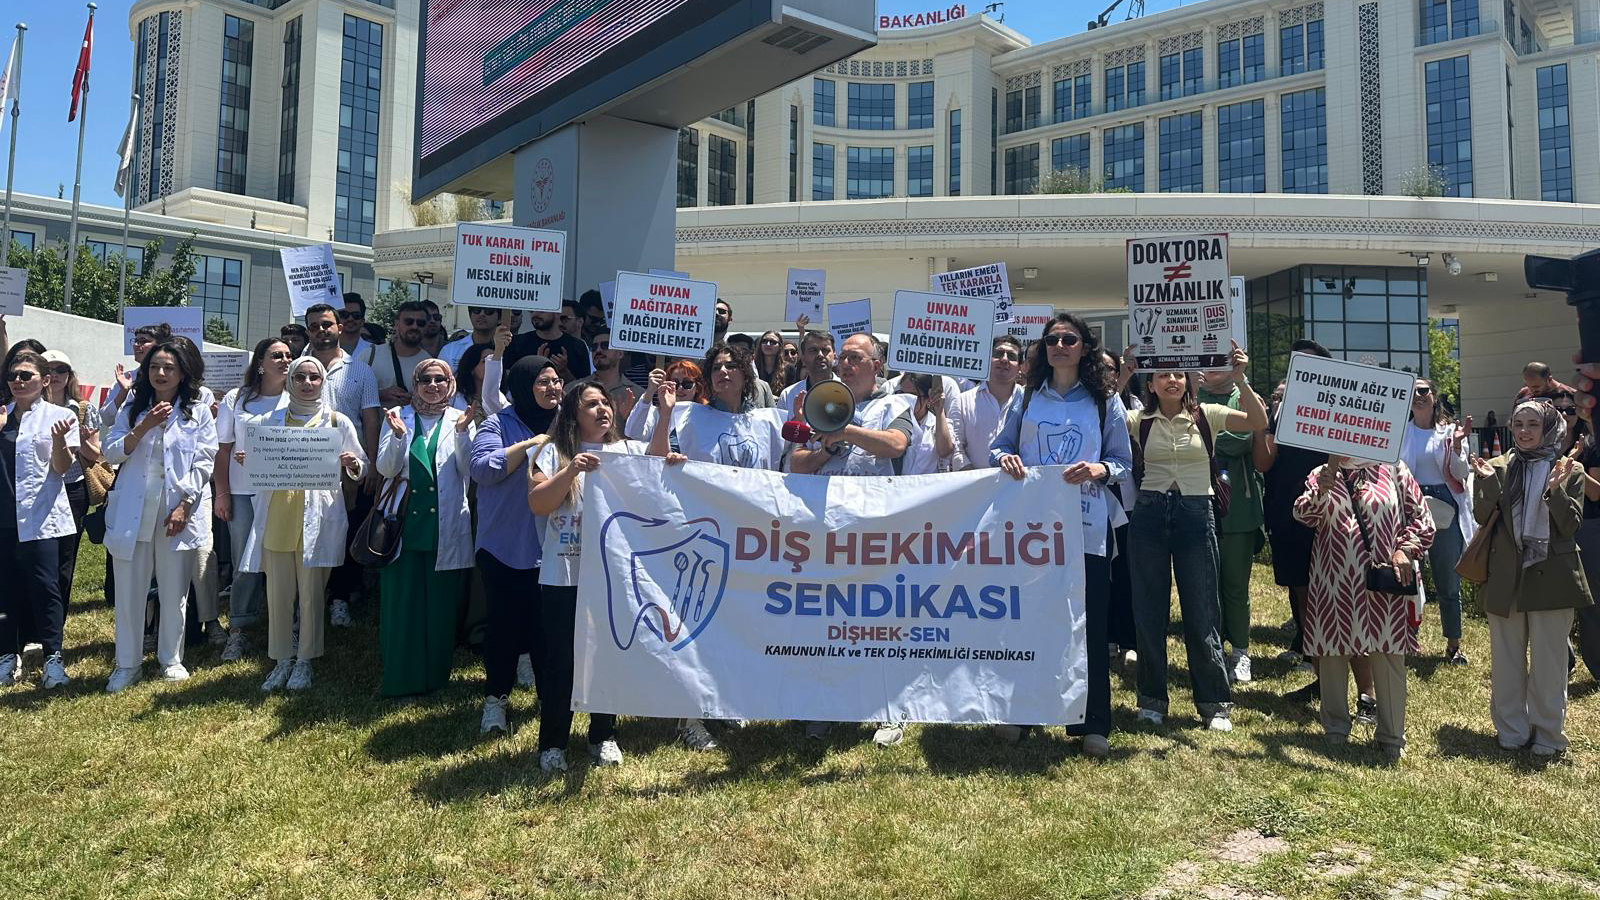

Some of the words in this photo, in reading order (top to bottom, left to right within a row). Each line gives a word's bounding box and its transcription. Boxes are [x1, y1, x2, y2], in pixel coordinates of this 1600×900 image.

[880, 4, 965, 28] BAKANLIĞI
[462, 234, 482, 246] TUK
[486, 236, 524, 250] KARARI
[532, 238, 560, 254] İPTAL
[1132, 238, 1222, 264] DOKTORA
[490, 252, 533, 269] EDİLSİN,
[466, 268, 513, 282] MESLEKİ
[516, 270, 551, 286] BİRLİK
[938, 270, 973, 283] YILLARIN
[974, 265, 999, 276] EMEĞİ
[941, 282, 957, 292] TEK
[960, 274, 1002, 288] KARARLA
[476, 286, 539, 301] KORUNSUN!
[650, 284, 690, 299] UNVAN
[1134, 280, 1224, 303] UZMANLIK
[630, 298, 698, 316] DAĞITARAK
[927, 302, 968, 317] UNVAN
[1206, 306, 1225, 318] DUS
[622, 313, 702, 332] MAĞDURİYET
[907, 317, 976, 336] DAĞITARAK
[1166, 316, 1198, 324] SINAVIYLA
[619, 328, 705, 349] GİDERİLEMEZ!
[1008, 325, 1028, 336] EMEĞİ
[900, 333, 980, 353] MAĞDURİYET
[896, 349, 983, 371] GİDERİLEMEZ!
[1295, 370, 1358, 391] TOPLUMUN
[1360, 381, 1389, 397] AĞIZ
[1392, 388, 1407, 400] VE
[1317, 390, 1336, 407] DİŞ
[1339, 396, 1385, 414] SAĞLIĞI
[1296, 405, 1331, 421] KENDİ
[1334, 412, 1392, 433] KADERİNE
[1296, 422, 1325, 437] TERK
[1328, 425, 1389, 449] EDİLEMEZ!
[735, 519, 811, 573] DİŞ
[825, 520, 1065, 566] HEKİMLİĞİ
[764, 573, 1021, 620] SENDİKASI
[827, 621, 950, 646] DİŞHEK-SEN
[765, 645, 827, 657] KAMUNUN
[827, 644, 846, 658] İLK
[848, 649, 861, 658] ve
[864, 647, 885, 658] TEK
[887, 645, 907, 661] DİŞ
[909, 646, 970, 660] HEKİMLİĞİ
[972, 648, 1035, 662] SENDİKASI
